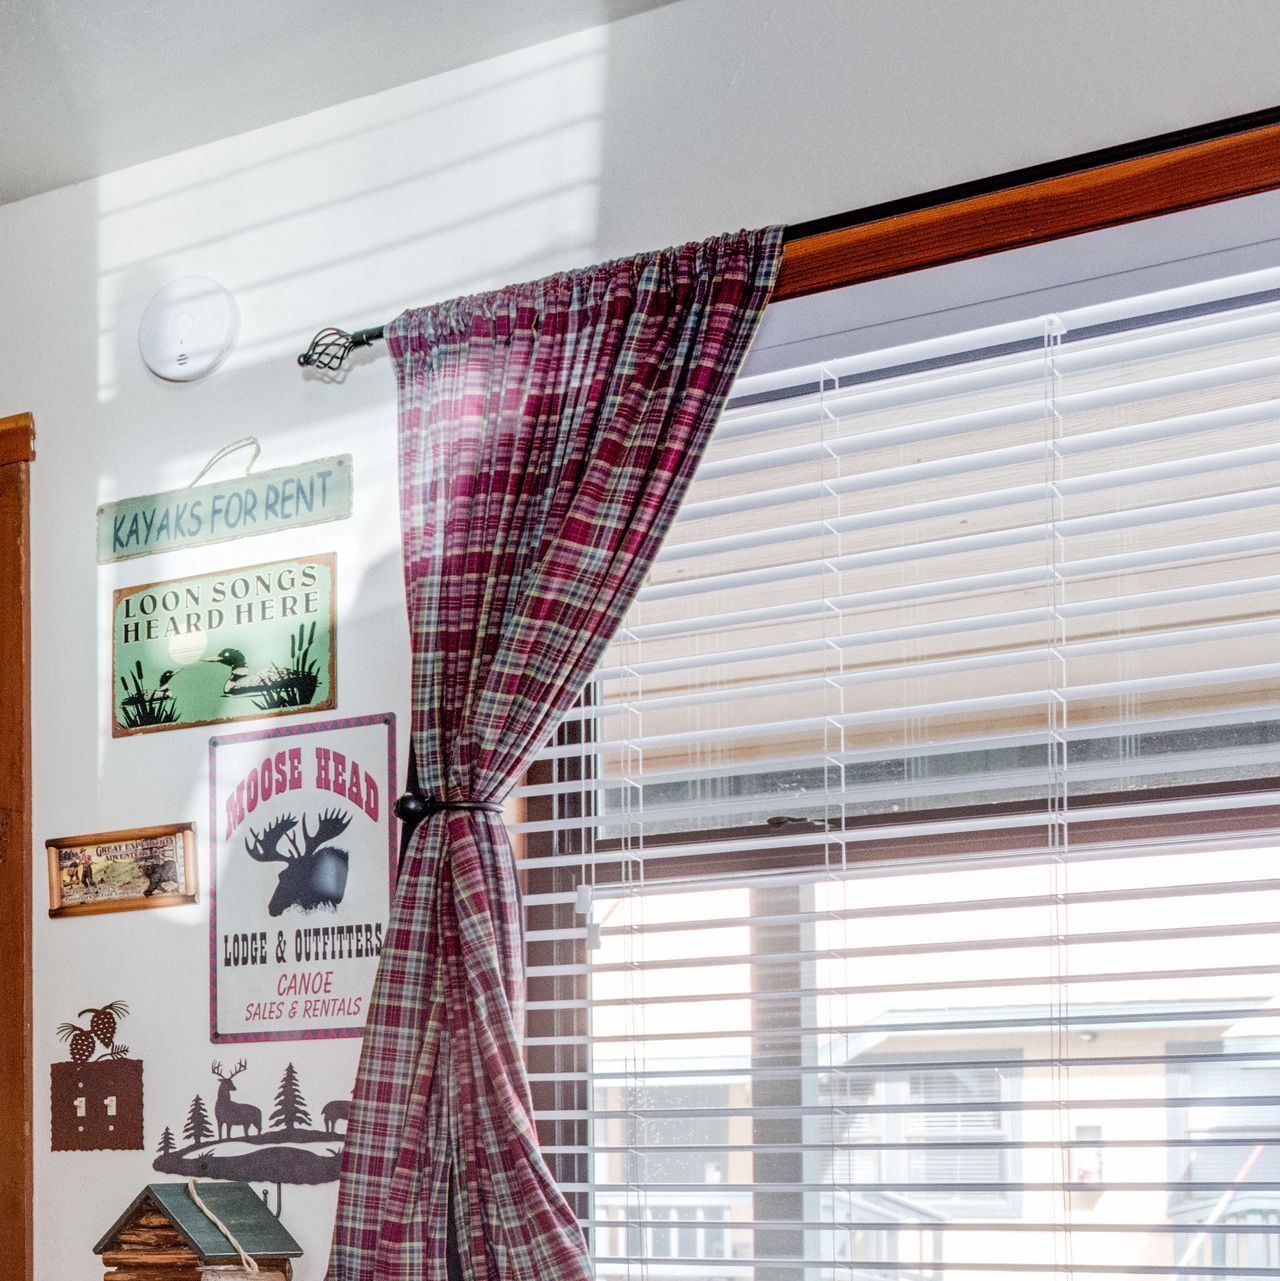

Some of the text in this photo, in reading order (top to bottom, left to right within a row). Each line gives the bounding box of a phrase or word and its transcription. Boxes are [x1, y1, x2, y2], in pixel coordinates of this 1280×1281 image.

[113, 470, 332, 552] KAYAKS FOR RENT
[124, 565, 317, 619] LOON SONGS
[123, 591, 319, 644] HEARD HERE
[225, 747, 379, 841] MOOSE HEAD
[95, 843, 123, 857] GREAT
[224, 922, 382, 967] LODGE & OUTFITTERS
[277, 971, 334, 996] CANOE
[245, 997, 362, 1021] SALES & RENTALS
